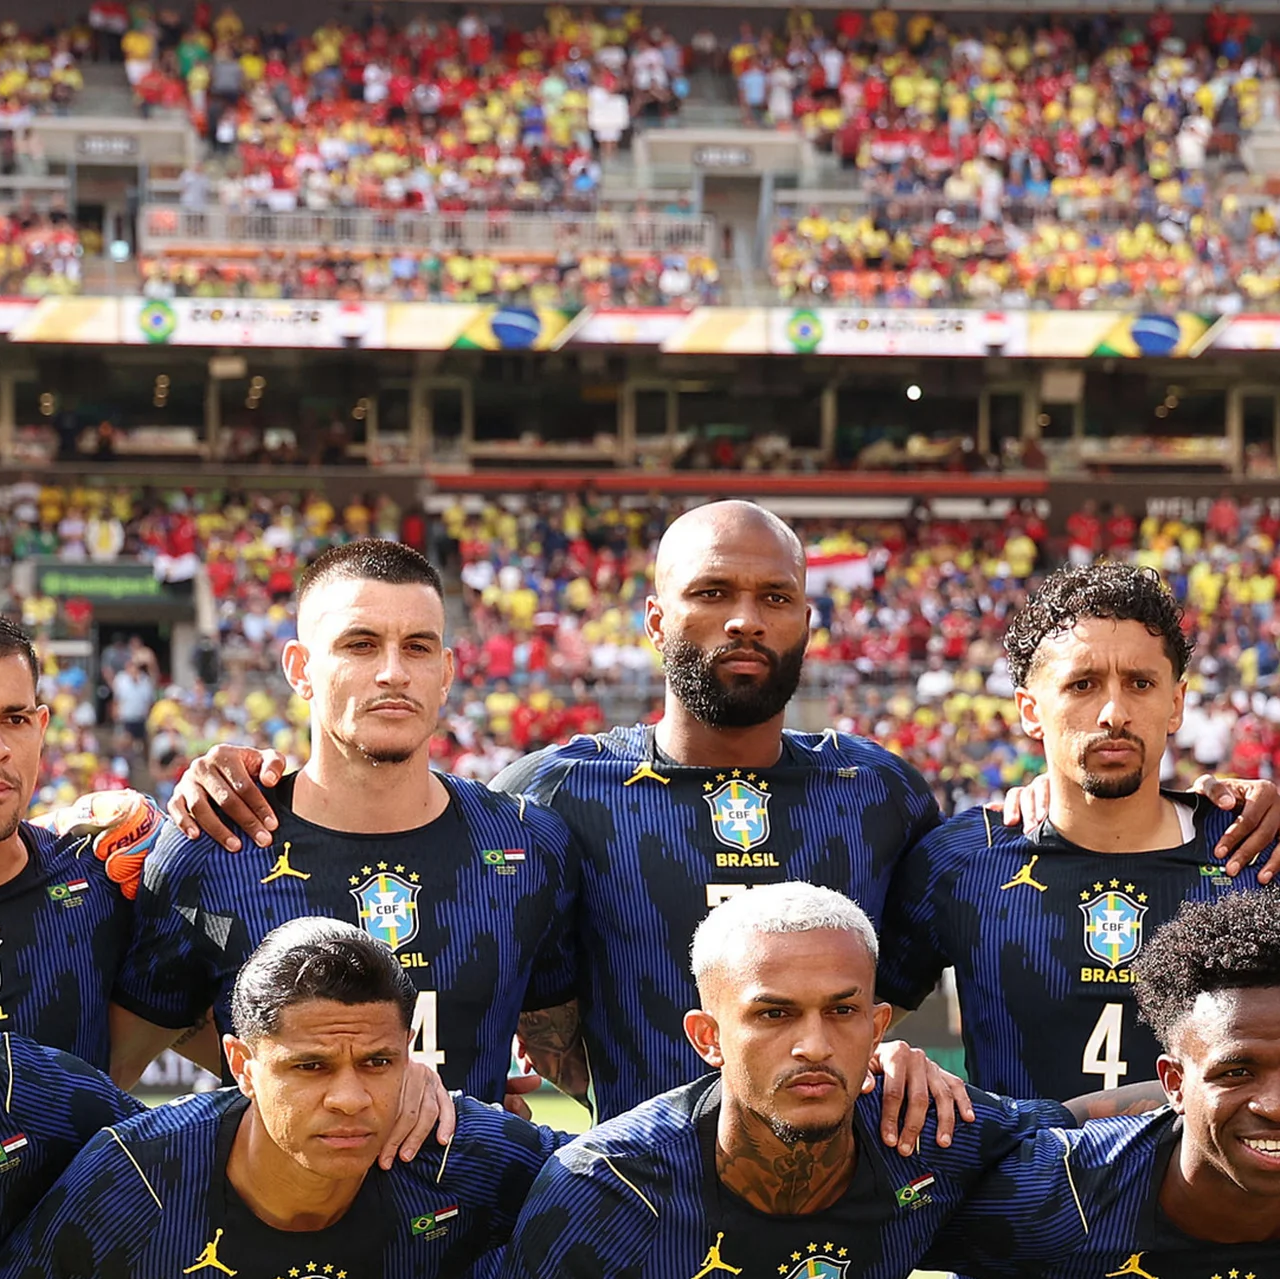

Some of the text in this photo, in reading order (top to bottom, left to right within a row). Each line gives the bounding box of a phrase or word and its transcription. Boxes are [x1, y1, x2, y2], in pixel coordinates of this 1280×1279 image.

[729, 810, 750, 820] CBF
[716, 853, 780, 867] BRASIL
[376, 904, 400, 915] CBF
[1102, 922, 1124, 931] CBF
[1081, 968, 1140, 983] BRASI
[1082, 1002, 1128, 1091] 4
